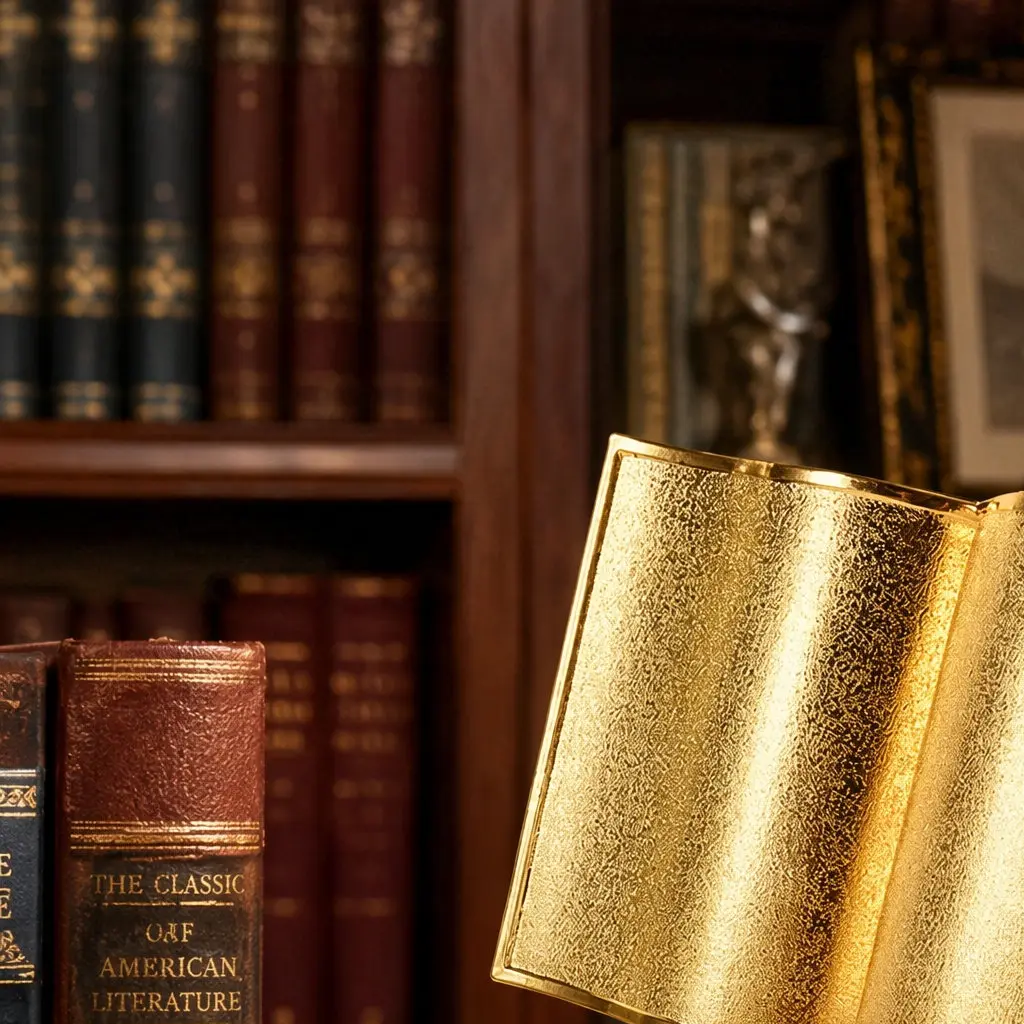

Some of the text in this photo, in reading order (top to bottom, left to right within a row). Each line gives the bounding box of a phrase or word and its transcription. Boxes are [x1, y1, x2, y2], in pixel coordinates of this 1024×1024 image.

[90, 873, 245, 895] THE CLASSIC
[99, 956, 238, 979] AMERICAN
[91, 991, 242, 1013] LITERATURE
